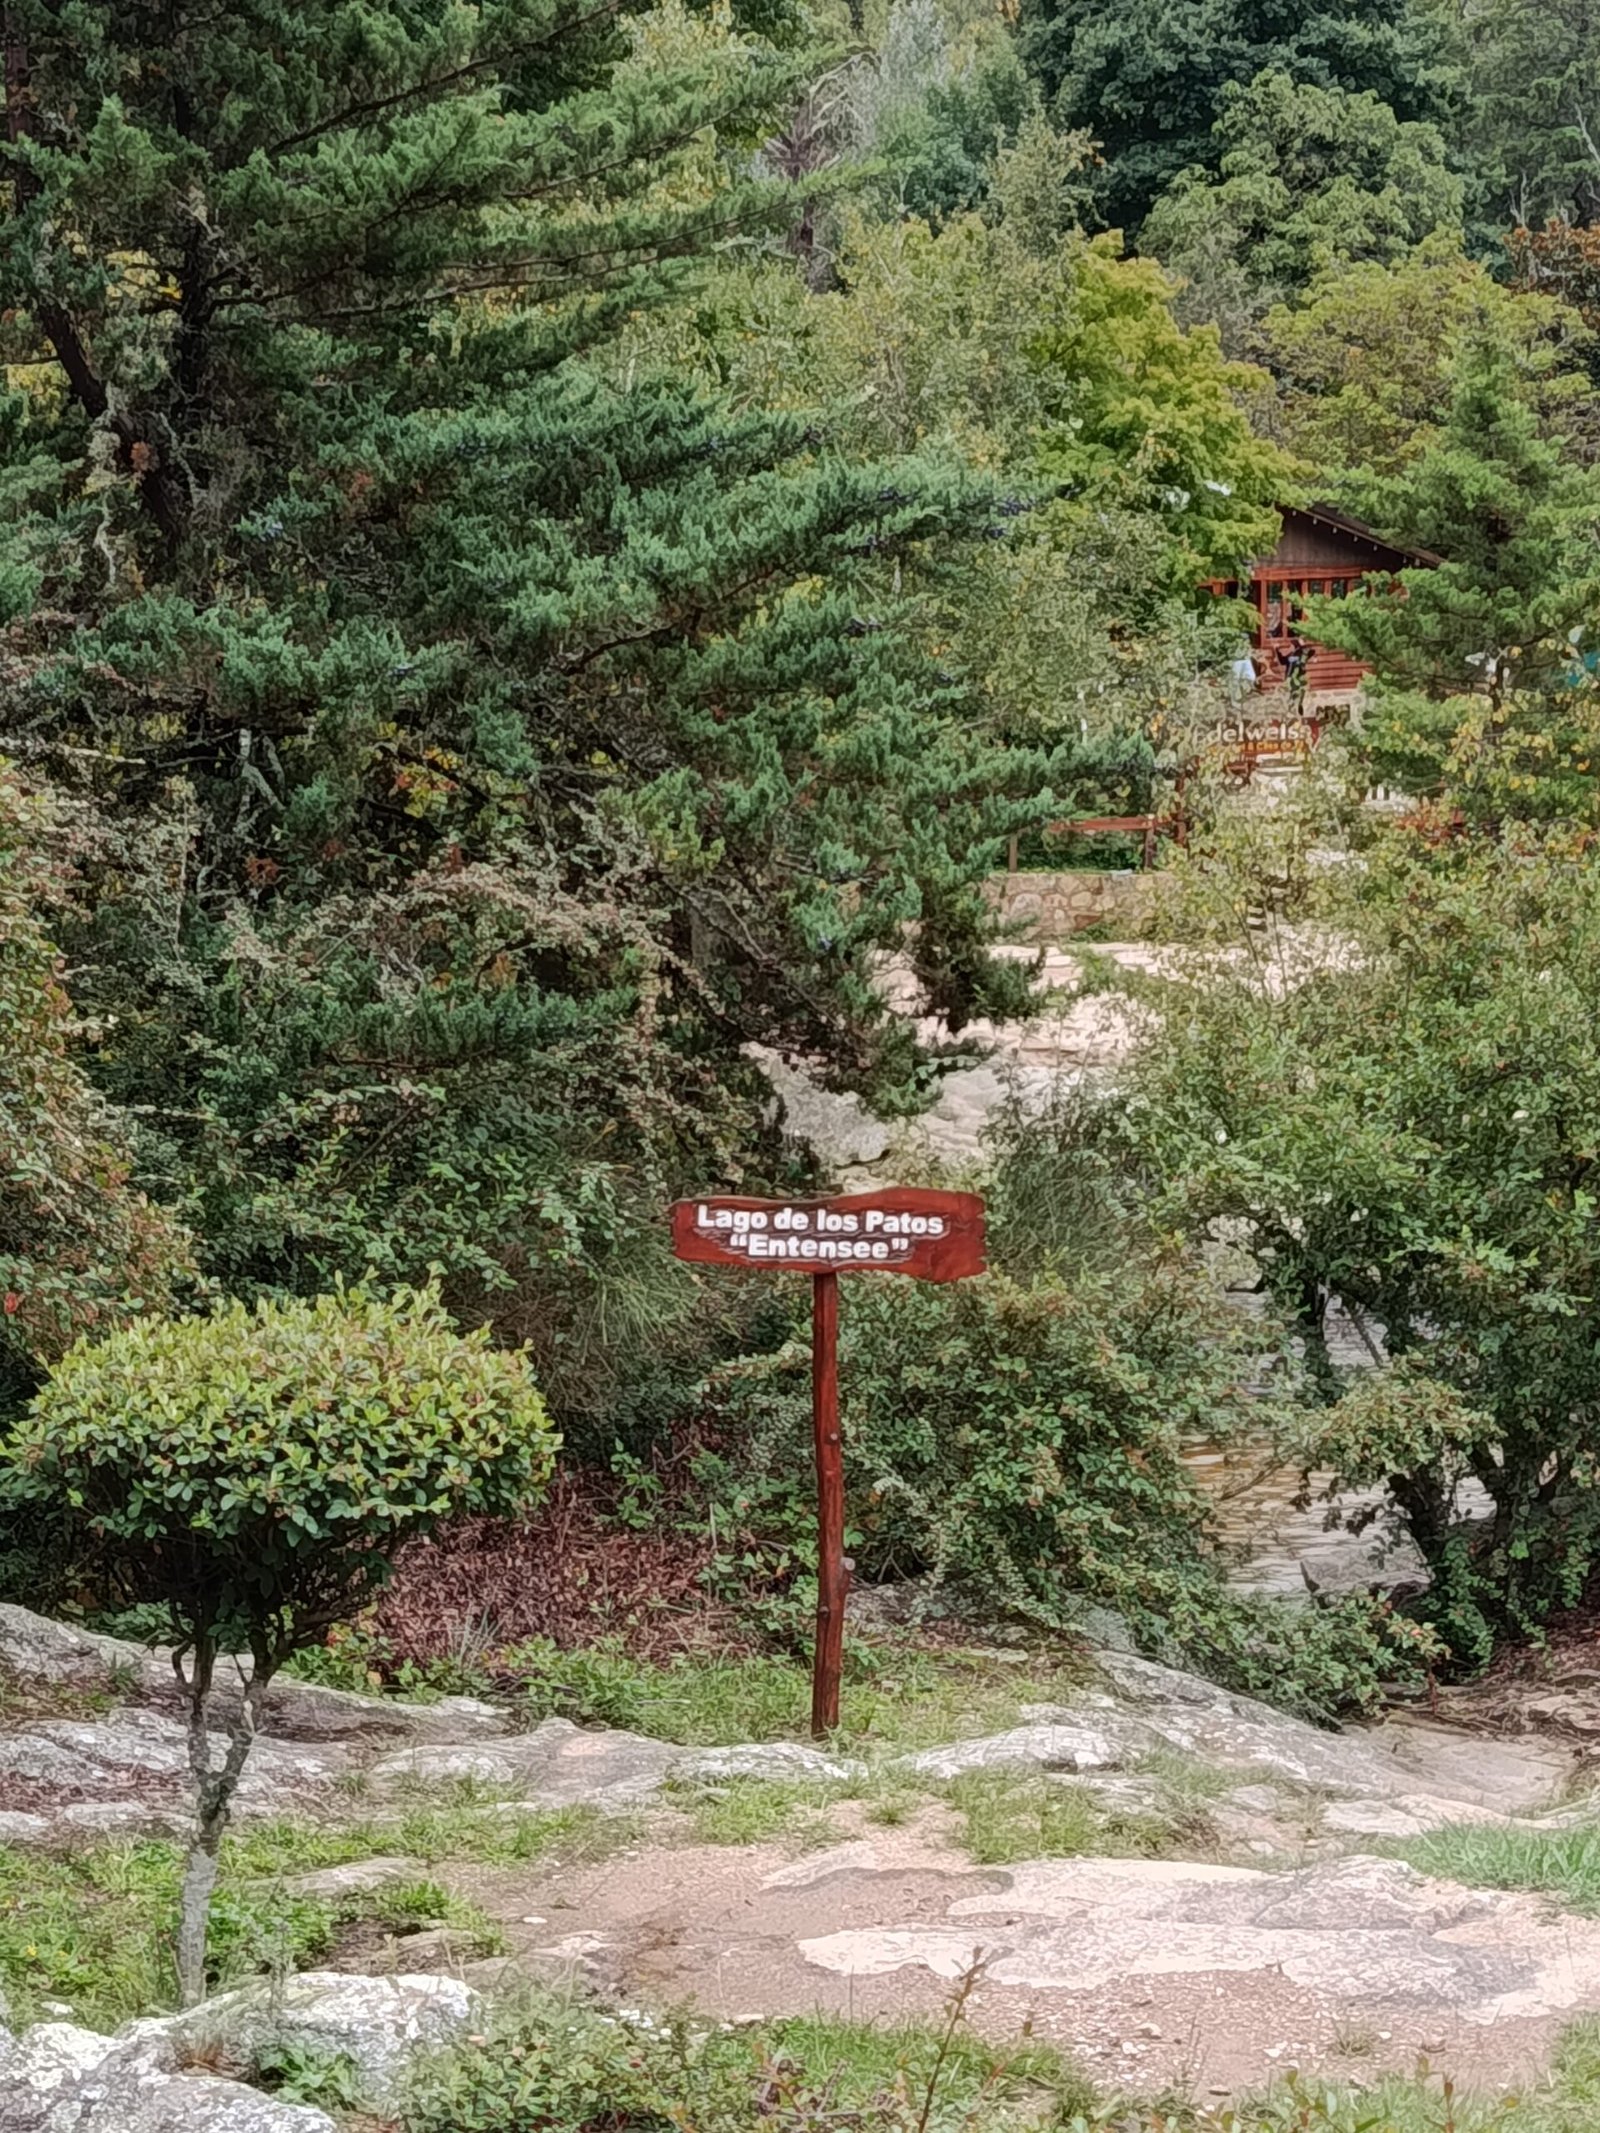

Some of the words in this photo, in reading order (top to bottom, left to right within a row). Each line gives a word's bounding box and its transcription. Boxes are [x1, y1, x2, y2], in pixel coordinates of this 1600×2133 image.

[697, 1204, 768, 1233] Lago
[773, 1207, 808, 1230] de
[816, 1209, 859, 1232] los
[865, 1210, 944, 1235] Patos
[729, 1234, 909, 1259] “Entensee”
